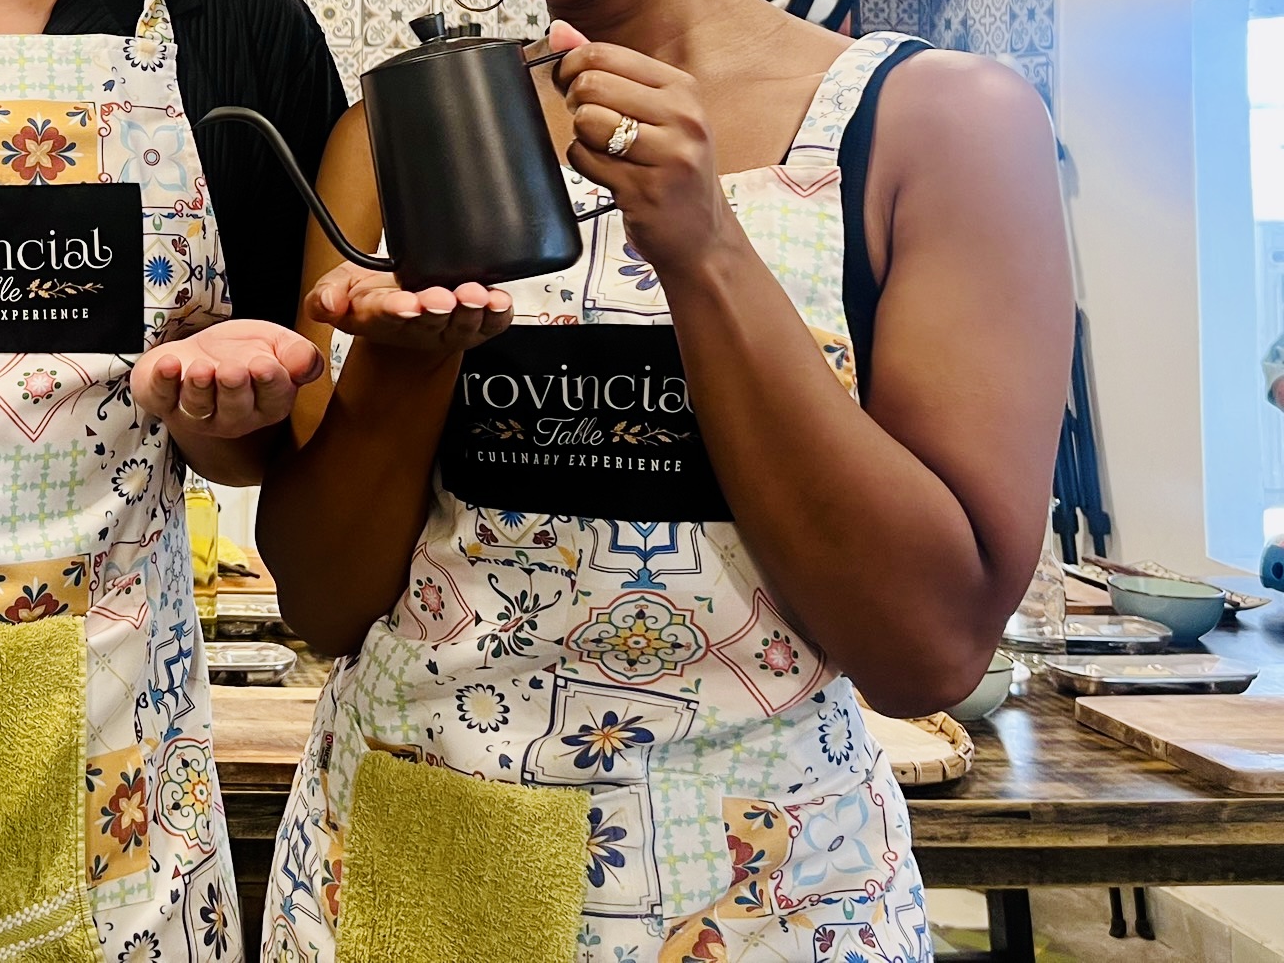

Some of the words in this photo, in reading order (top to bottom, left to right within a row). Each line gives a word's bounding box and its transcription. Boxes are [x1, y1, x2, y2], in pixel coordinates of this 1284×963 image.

[462, 364, 694, 414] rovincia
[533, 417, 605, 447] Table
[477, 450, 560, 466] CULINARY
[568, 454, 682, 472] EXPERIENCE
